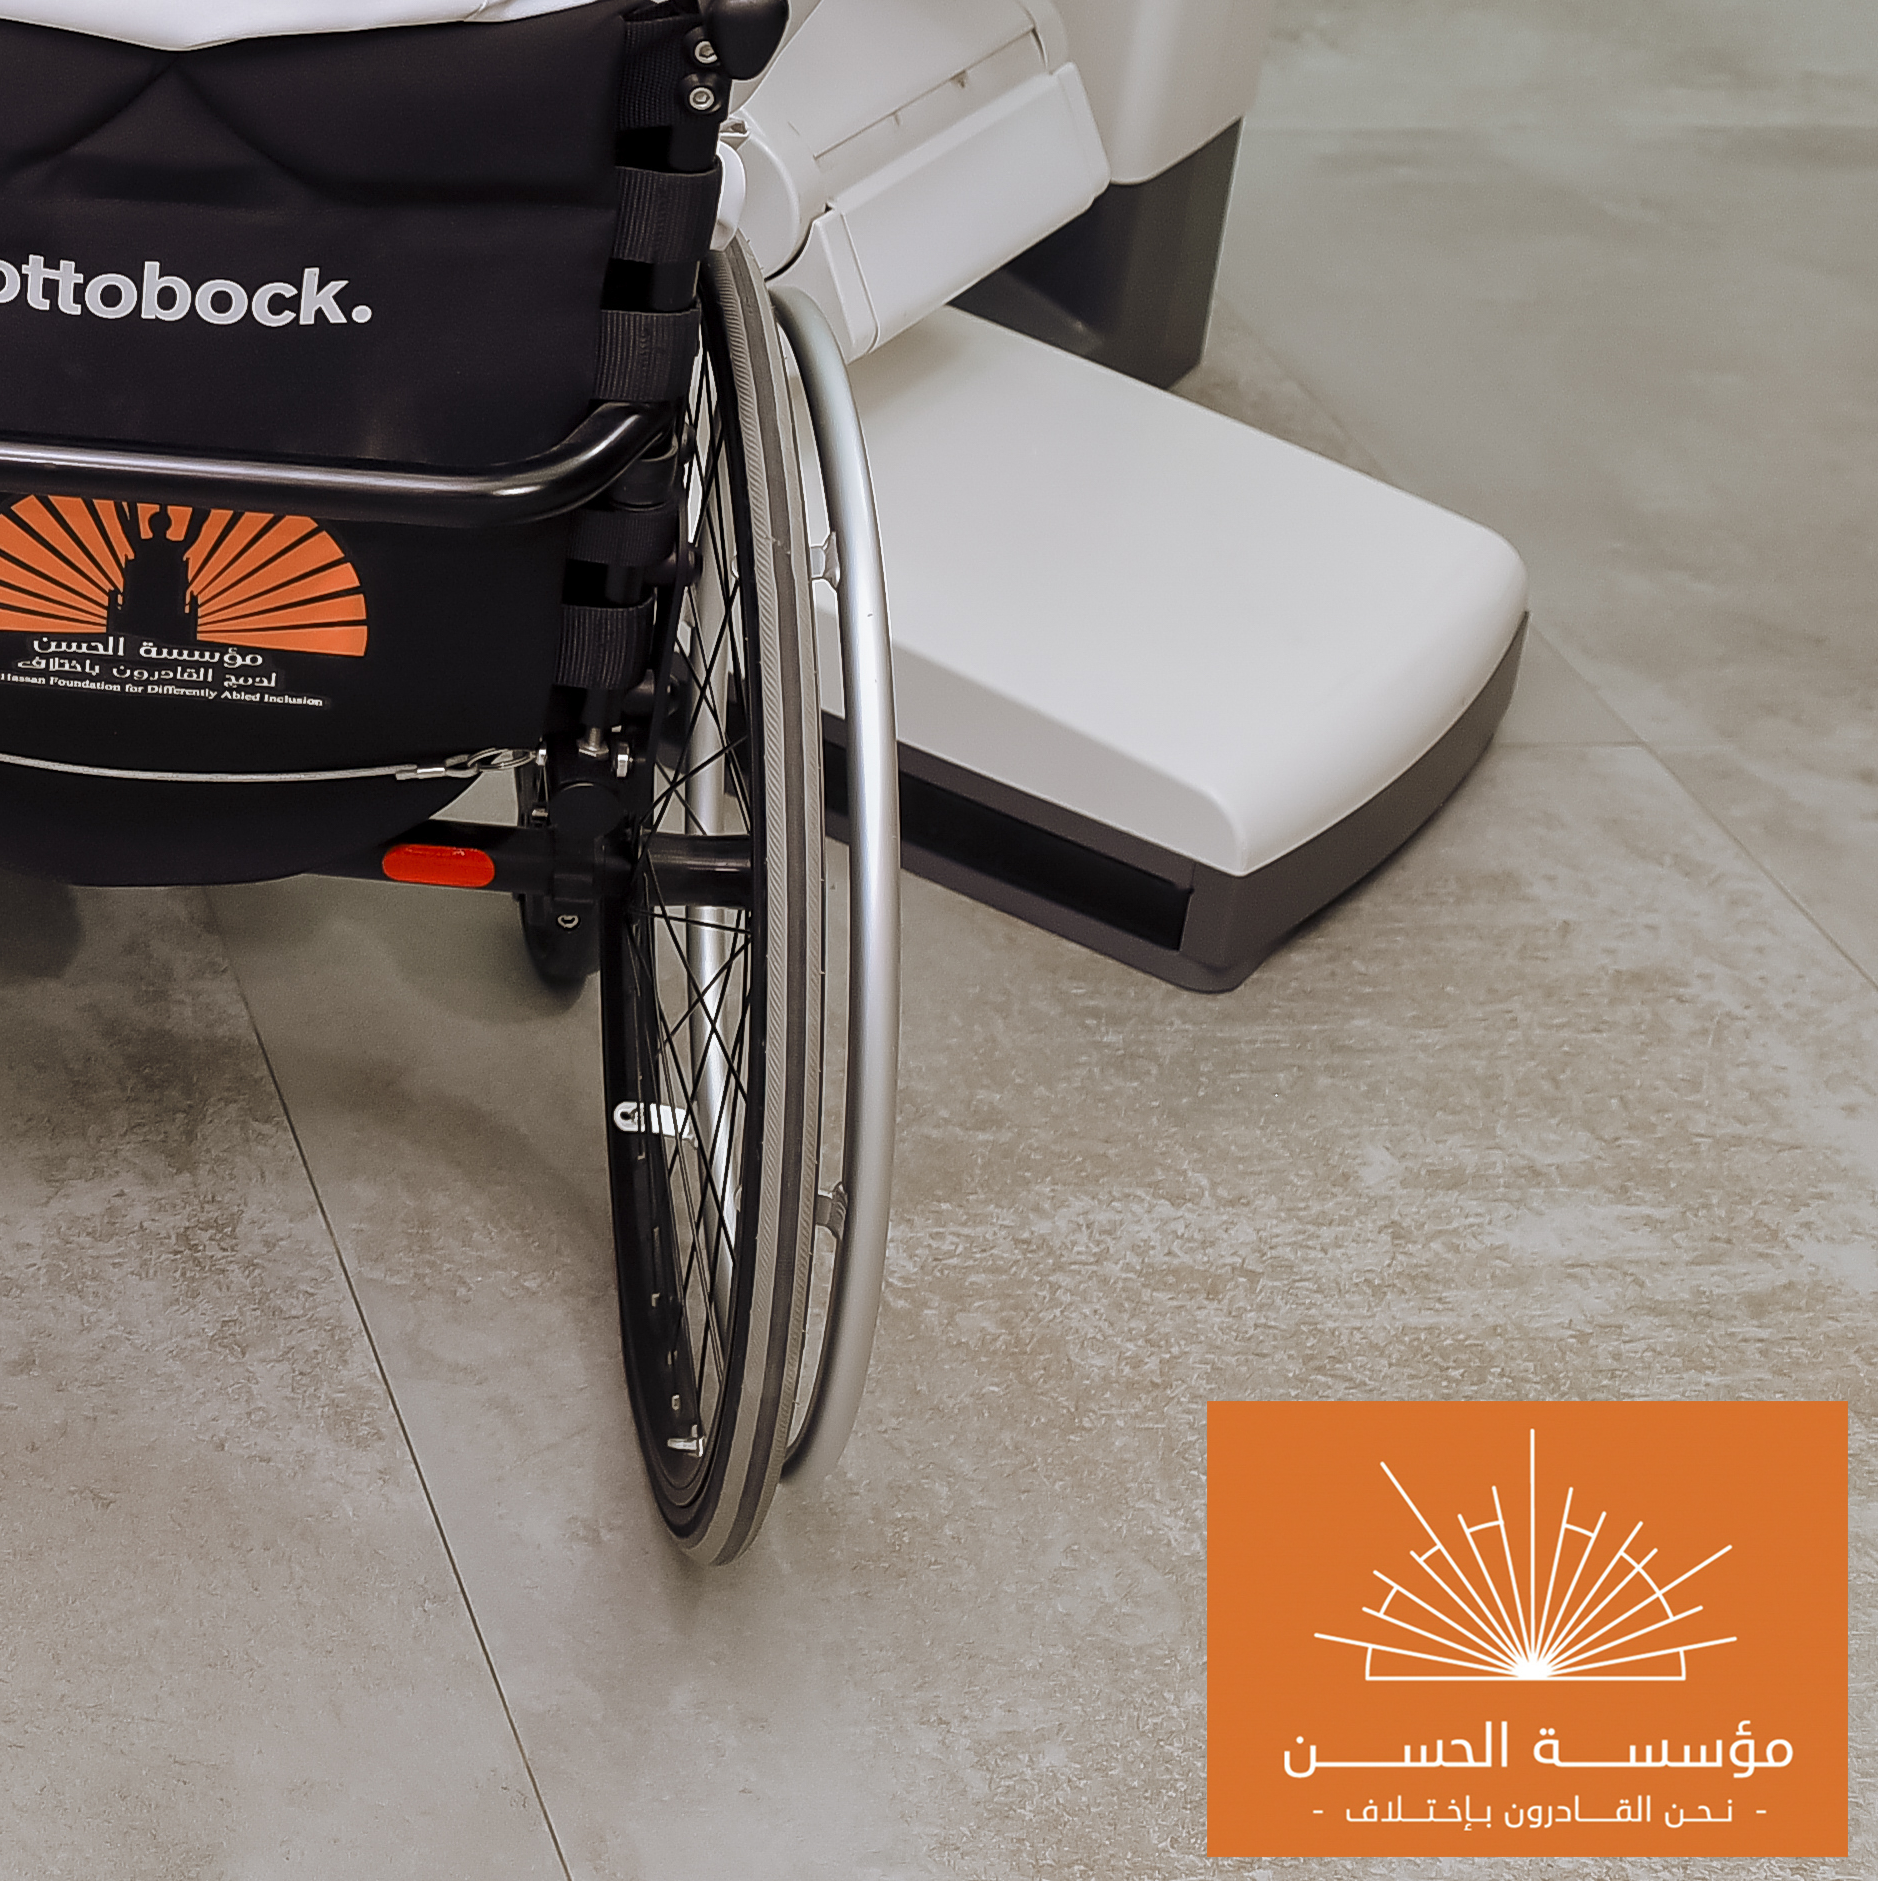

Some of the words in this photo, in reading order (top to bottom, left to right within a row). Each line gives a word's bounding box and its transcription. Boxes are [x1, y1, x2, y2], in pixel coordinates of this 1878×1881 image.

[33, 636, 125, 657] الحسن
[139, 640, 263, 668] مؤسسة
[49, 676, 121, 692] Foundation
[125, 683, 144, 694] for
